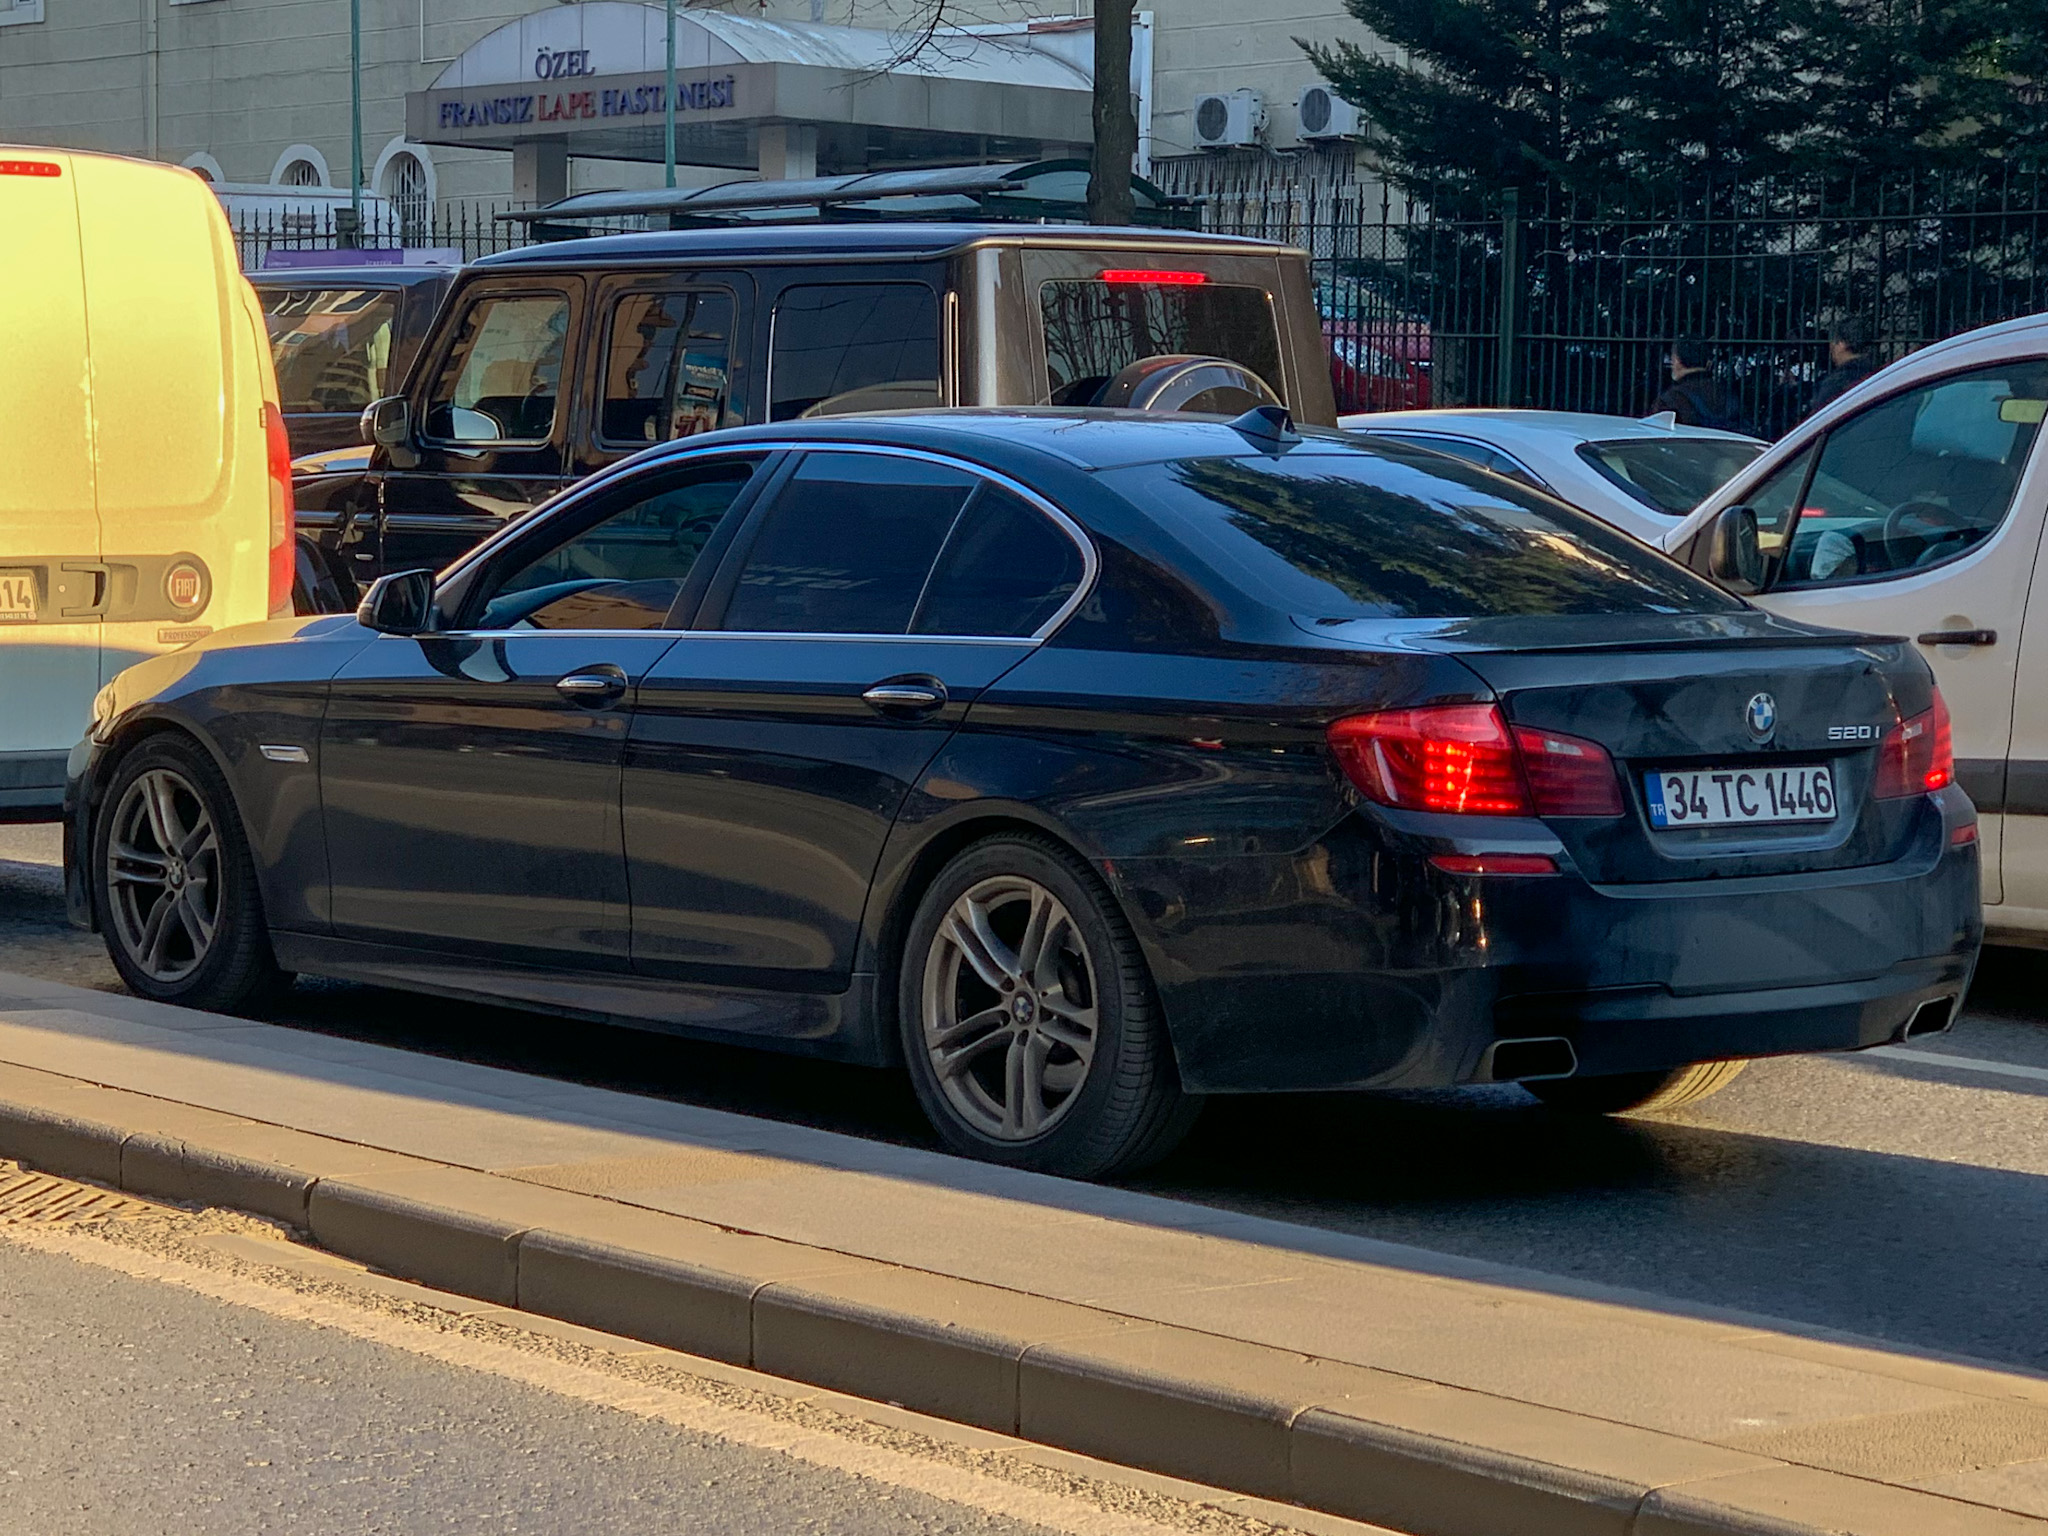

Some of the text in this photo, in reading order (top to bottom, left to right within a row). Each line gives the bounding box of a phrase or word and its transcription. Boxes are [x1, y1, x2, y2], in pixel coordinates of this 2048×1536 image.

[535, 46, 596, 79] ÖZEL
[438, 74, 735, 129] FRANSIZ LAPE HASTNESİ
[0, 579, 31, 609] 14
[175, 578, 195, 597] FIAT
[1651, 803, 1665, 817] TR
[1666, 771, 1833, 820] 34 TC 1446
